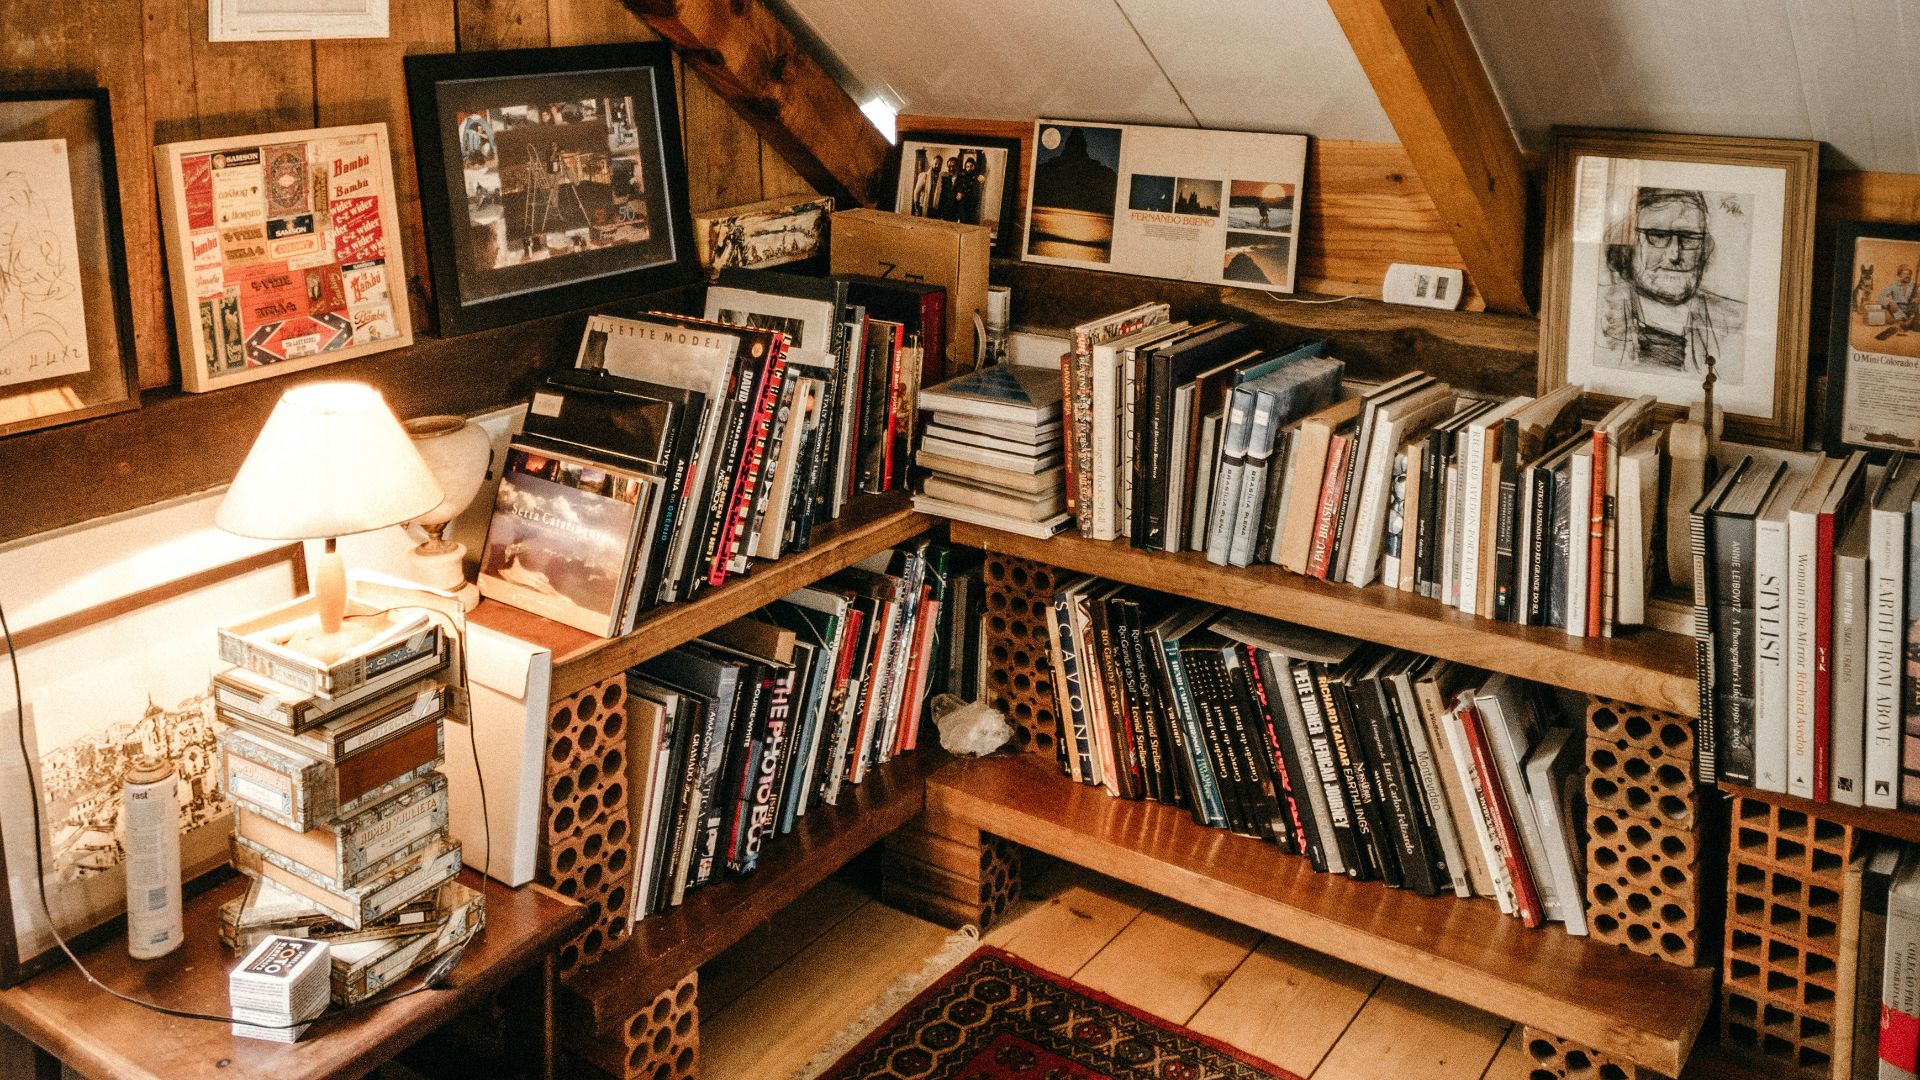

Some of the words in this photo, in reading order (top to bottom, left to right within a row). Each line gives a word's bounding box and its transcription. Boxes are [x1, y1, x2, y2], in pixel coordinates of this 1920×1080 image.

[226, 152, 259, 163] SAMSON
[330, 199, 352, 215] wider
[350, 199, 373, 216] wider
[1131, 212, 1181, 225] FERNANDO
[1183, 215, 1215, 228] BUENO
[275, 226, 307, 237] SAMSON
[356, 218, 380, 235] wider
[350, 233, 374, 250] wider
[590, 321, 655, 339] LISETTE
[663, 331, 721, 349] MODEL
[1862, 354, 1879, 364] Mini
[1880, 356, 1914, 368] Colorado
[737, 369, 753, 403] DAVID
[755, 339, 782, 414] HOTEL
[889, 391, 899, 414] spirit
[1095, 436, 1105, 463] Images
[1470, 431, 1480, 480] RICHARD
[670, 458, 686, 492] ARENA
[1097, 465, 1105, 474] of
[1097, 474, 1105, 494] Rock
[714, 418, 761, 572] LACHAPELLE
[1467, 484, 1478, 525] AVEDON
[1536, 479, 1544, 507] ANTIGAS
[510, 503, 540, 523] Serra
[1097, 507, 1105, 522] Roll
[1216, 508, 1226, 534] PLENA
[1240, 510, 1250, 536] PLENA
[1534, 508, 1543, 540] FAZENDAS
[1310, 499, 1337, 562] PAU-BRASIL
[1464, 528, 1476, 588] PORTRAITS
[1535, 541, 1541, 551] DO
[1731, 540, 1741, 567] ANNIE
[1796, 553, 1807, 595] Woman
[1843, 571, 1853, 599] IRVING
[1532, 592, 1538, 602] DO
[1730, 569, 1741, 612] LEIBOVITZ
[1797, 598, 1807, 609] in
[1876, 576, 1895, 632] EARTH
[1760, 574, 1781, 670] STYLIST
[1796, 611, 1807, 629] the
[1843, 601, 1852, 624] PENN
[1117, 624, 1128, 639] Rio
[1130, 628, 1141, 643] Rio
[1842, 626, 1852, 650] SMALL
[1120, 638, 1132, 666] Grande
[1133, 642, 1146, 671] Grande
[1729, 627, 1740, 681] Photographer's
[1796, 630, 1807, 667] Mirror
[1875, 639, 1894, 685] FROM
[1053, 599, 1092, 765] SCAVONE
[1102, 646, 1116, 682] GRANDE
[1110, 698, 1121, 716] SUL
[1125, 666, 1133, 678] do
[1138, 671, 1147, 683] do
[1292, 667, 1312, 697] PETE
[1842, 653, 1852, 683] TRADES
[855, 662, 873, 715] CAMERA
[1125, 677, 1136, 694] Sul
[1139, 682, 1150, 698] Sul
[1314, 674, 1340, 724] RICHARD
[1794, 670, 1808, 715] Richard
[740, 682, 764, 748] BOURKE-WHITE
[1130, 705, 1143, 733] Leonid
[1200, 700, 1213, 728] Brasil
[1213, 704, 1227, 732] Brasil
[1231, 703, 1242, 731] Brasil
[1300, 694, 1323, 736] TURNER
[1424, 698, 1433, 712] Bob
[1873, 690, 1892, 747] ABOVE
[1144, 710, 1158, 738] Leonid
[1208, 728, 1217, 741] do
[1222, 732, 1230, 745] do
[1239, 731, 1248, 744] do
[1794, 718, 1806, 756] Avedon
[683, 732, 702, 782] GRAMADO
[1135, 734, 1150, 768] Streliaev
[1149, 738, 1165, 773] Streliaev
[1213, 741, 1228, 778] Coração
[1307, 735, 1337, 784] AFRICAN
[1329, 723, 1352, 767] KALVAR
[1226, 745, 1241, 782] Coração
[1243, 744, 1259, 782] Coração
[1299, 745, 1315, 783] WOMEN
[1381, 760, 1395, 782] Luiz
[1411, 748, 1446, 812] Montevideo
[763, 792, 777, 826] Brasil
[1322, 780, 1352, 831] JOURNEY
[1338, 766, 1373, 835] EARTHLINGS
[1386, 781, 1404, 812] Carlos
[357, 820, 394, 845] ROMEO
[1394, 811, 1417, 855] Felizardo
[264, 943, 303, 974] FOTO
[1902, 941, 1918, 987] COLEÇÃO
